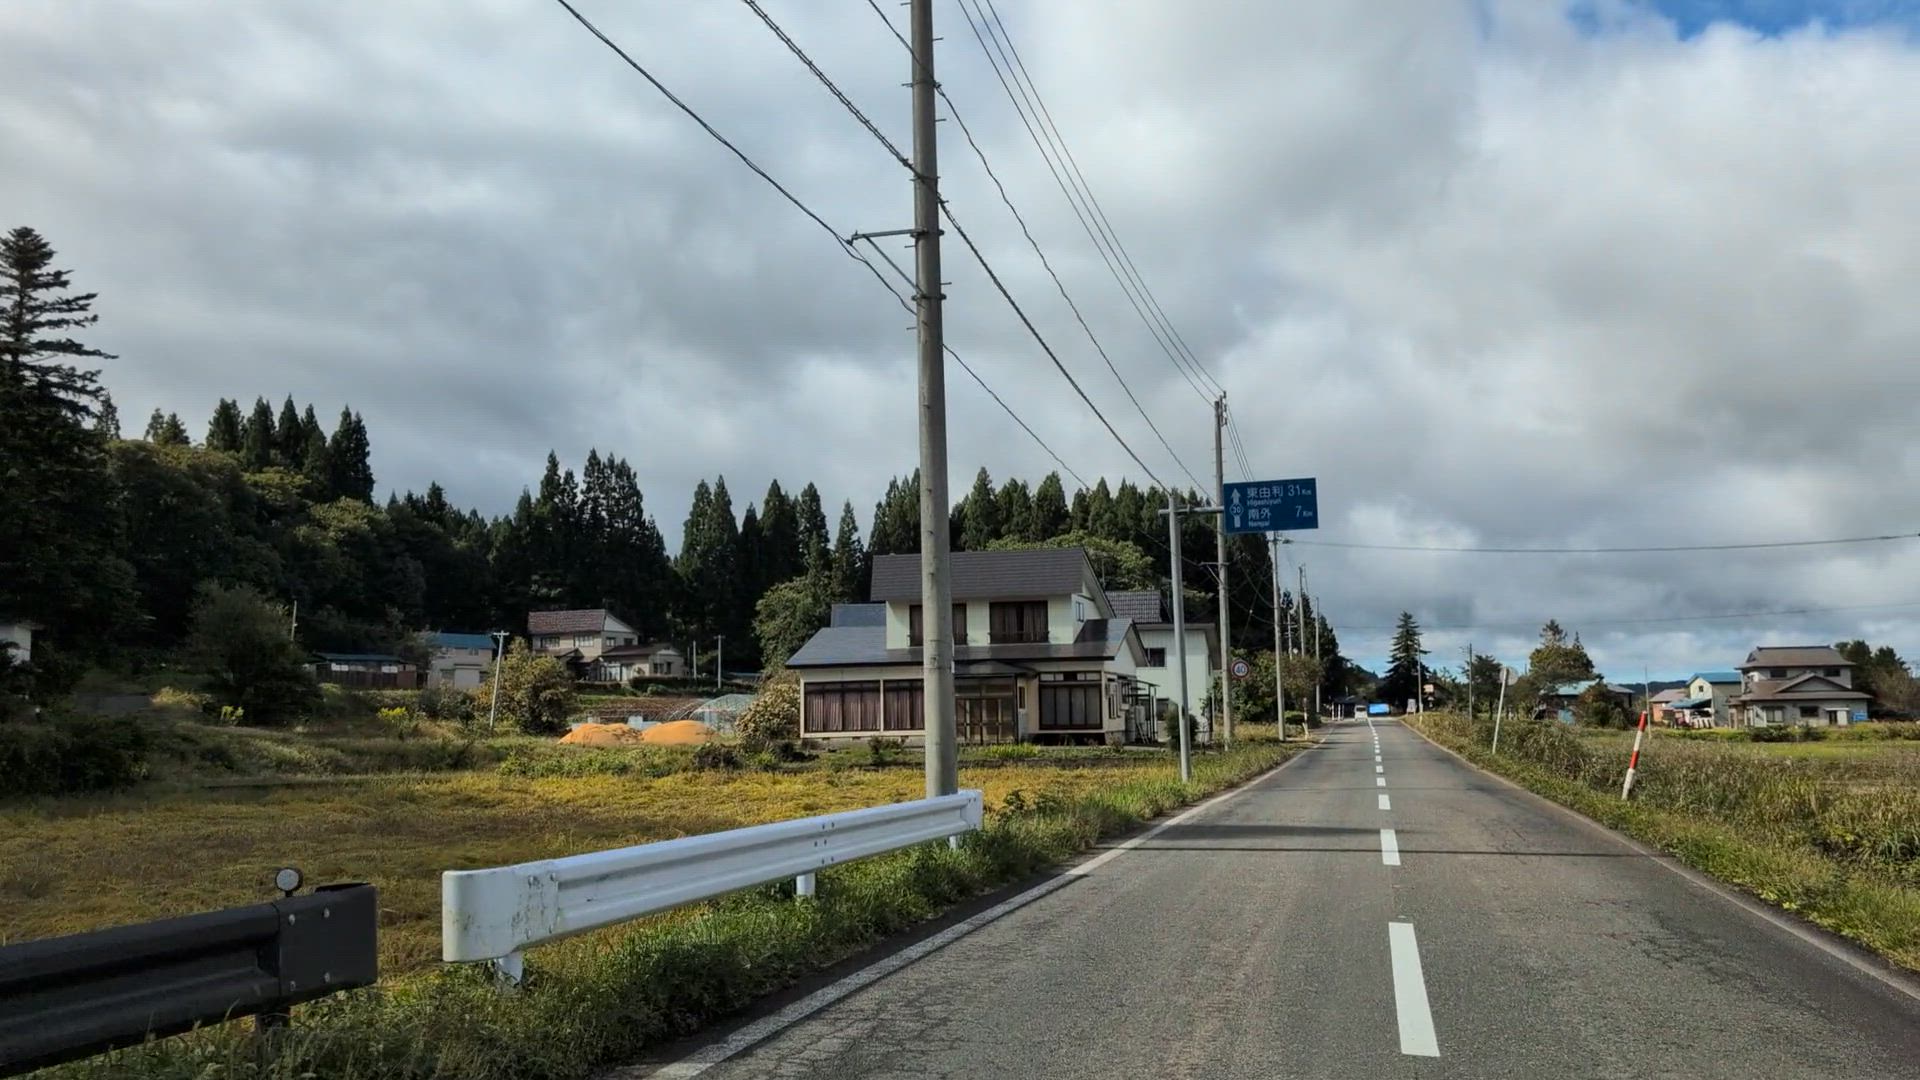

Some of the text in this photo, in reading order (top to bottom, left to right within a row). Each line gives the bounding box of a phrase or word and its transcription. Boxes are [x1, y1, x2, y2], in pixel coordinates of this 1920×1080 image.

[1247, 485, 1283, 498] 東由利
[1248, 507, 1272, 520] 南外
[1235, 664, 1246, 673] 40
